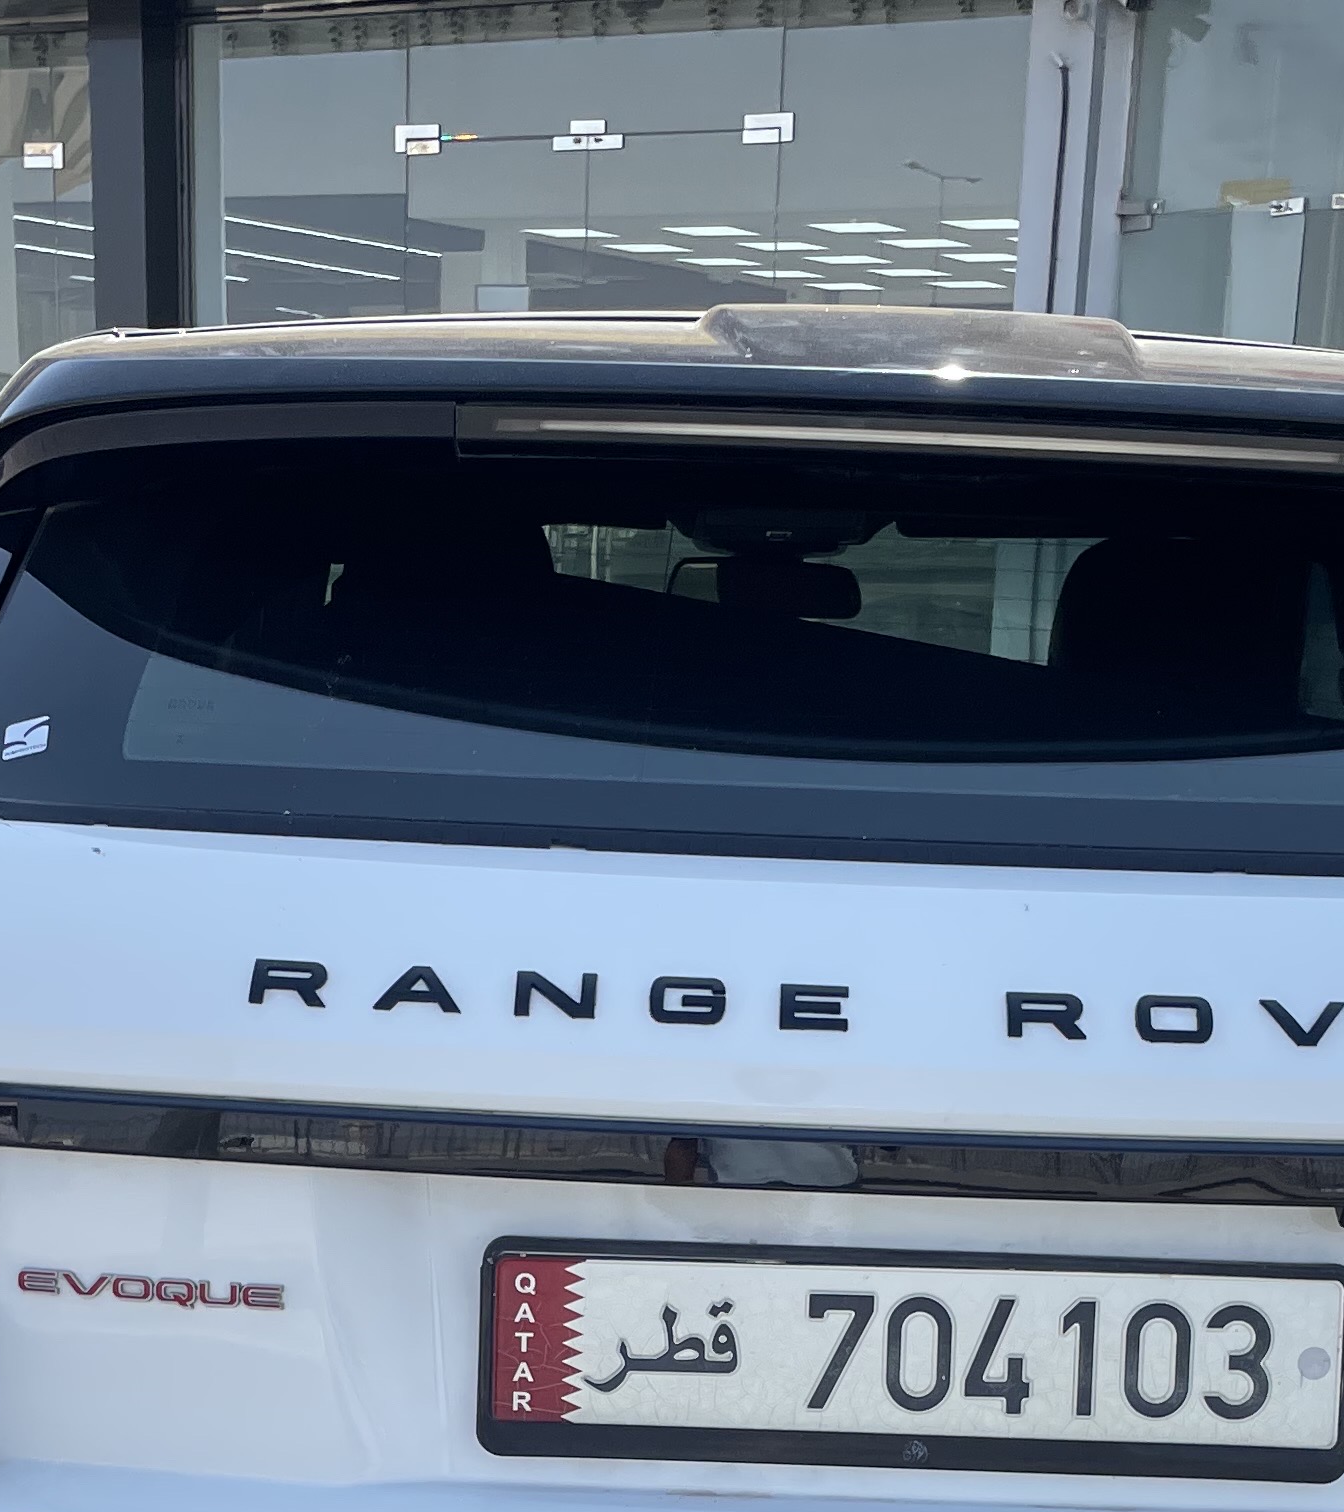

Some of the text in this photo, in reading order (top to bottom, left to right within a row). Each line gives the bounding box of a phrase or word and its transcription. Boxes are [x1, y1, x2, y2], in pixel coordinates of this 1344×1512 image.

[249, 958, 850, 1032] RANGE
[18, 1267, 285, 1311] EVOQUE
[512, 1272, 537, 1412] QATAR
[584, 1299, 738, 1393] قطر
[806, 1292, 1274, 1421] 704103
